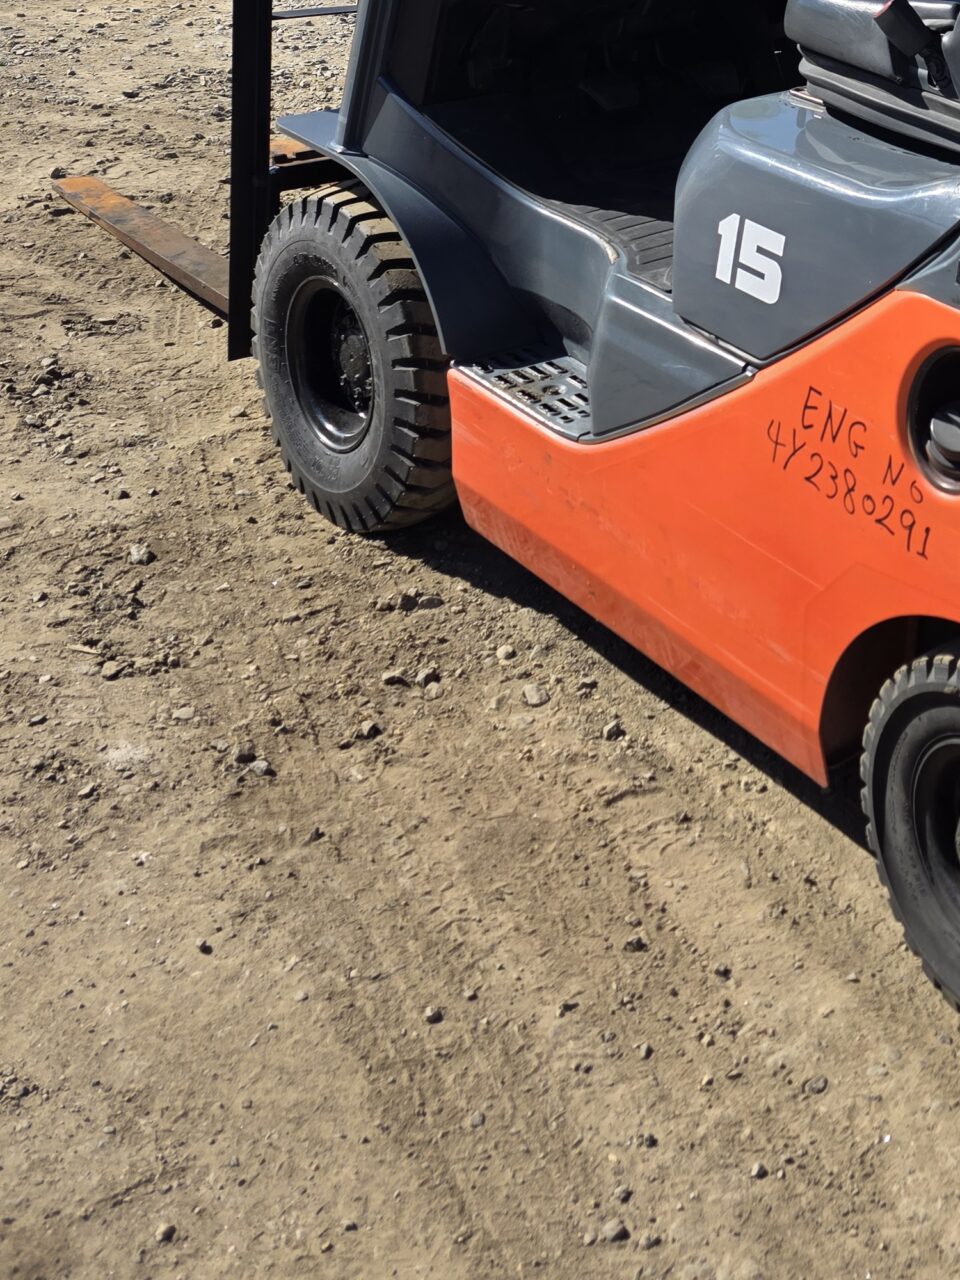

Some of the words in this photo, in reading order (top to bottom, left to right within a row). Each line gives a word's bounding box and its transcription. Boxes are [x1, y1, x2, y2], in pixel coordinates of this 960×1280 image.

[715, 213, 786, 305] 15
[802, 386, 867, 458] ENG
[767, 419, 931, 560] 4Y2380291
